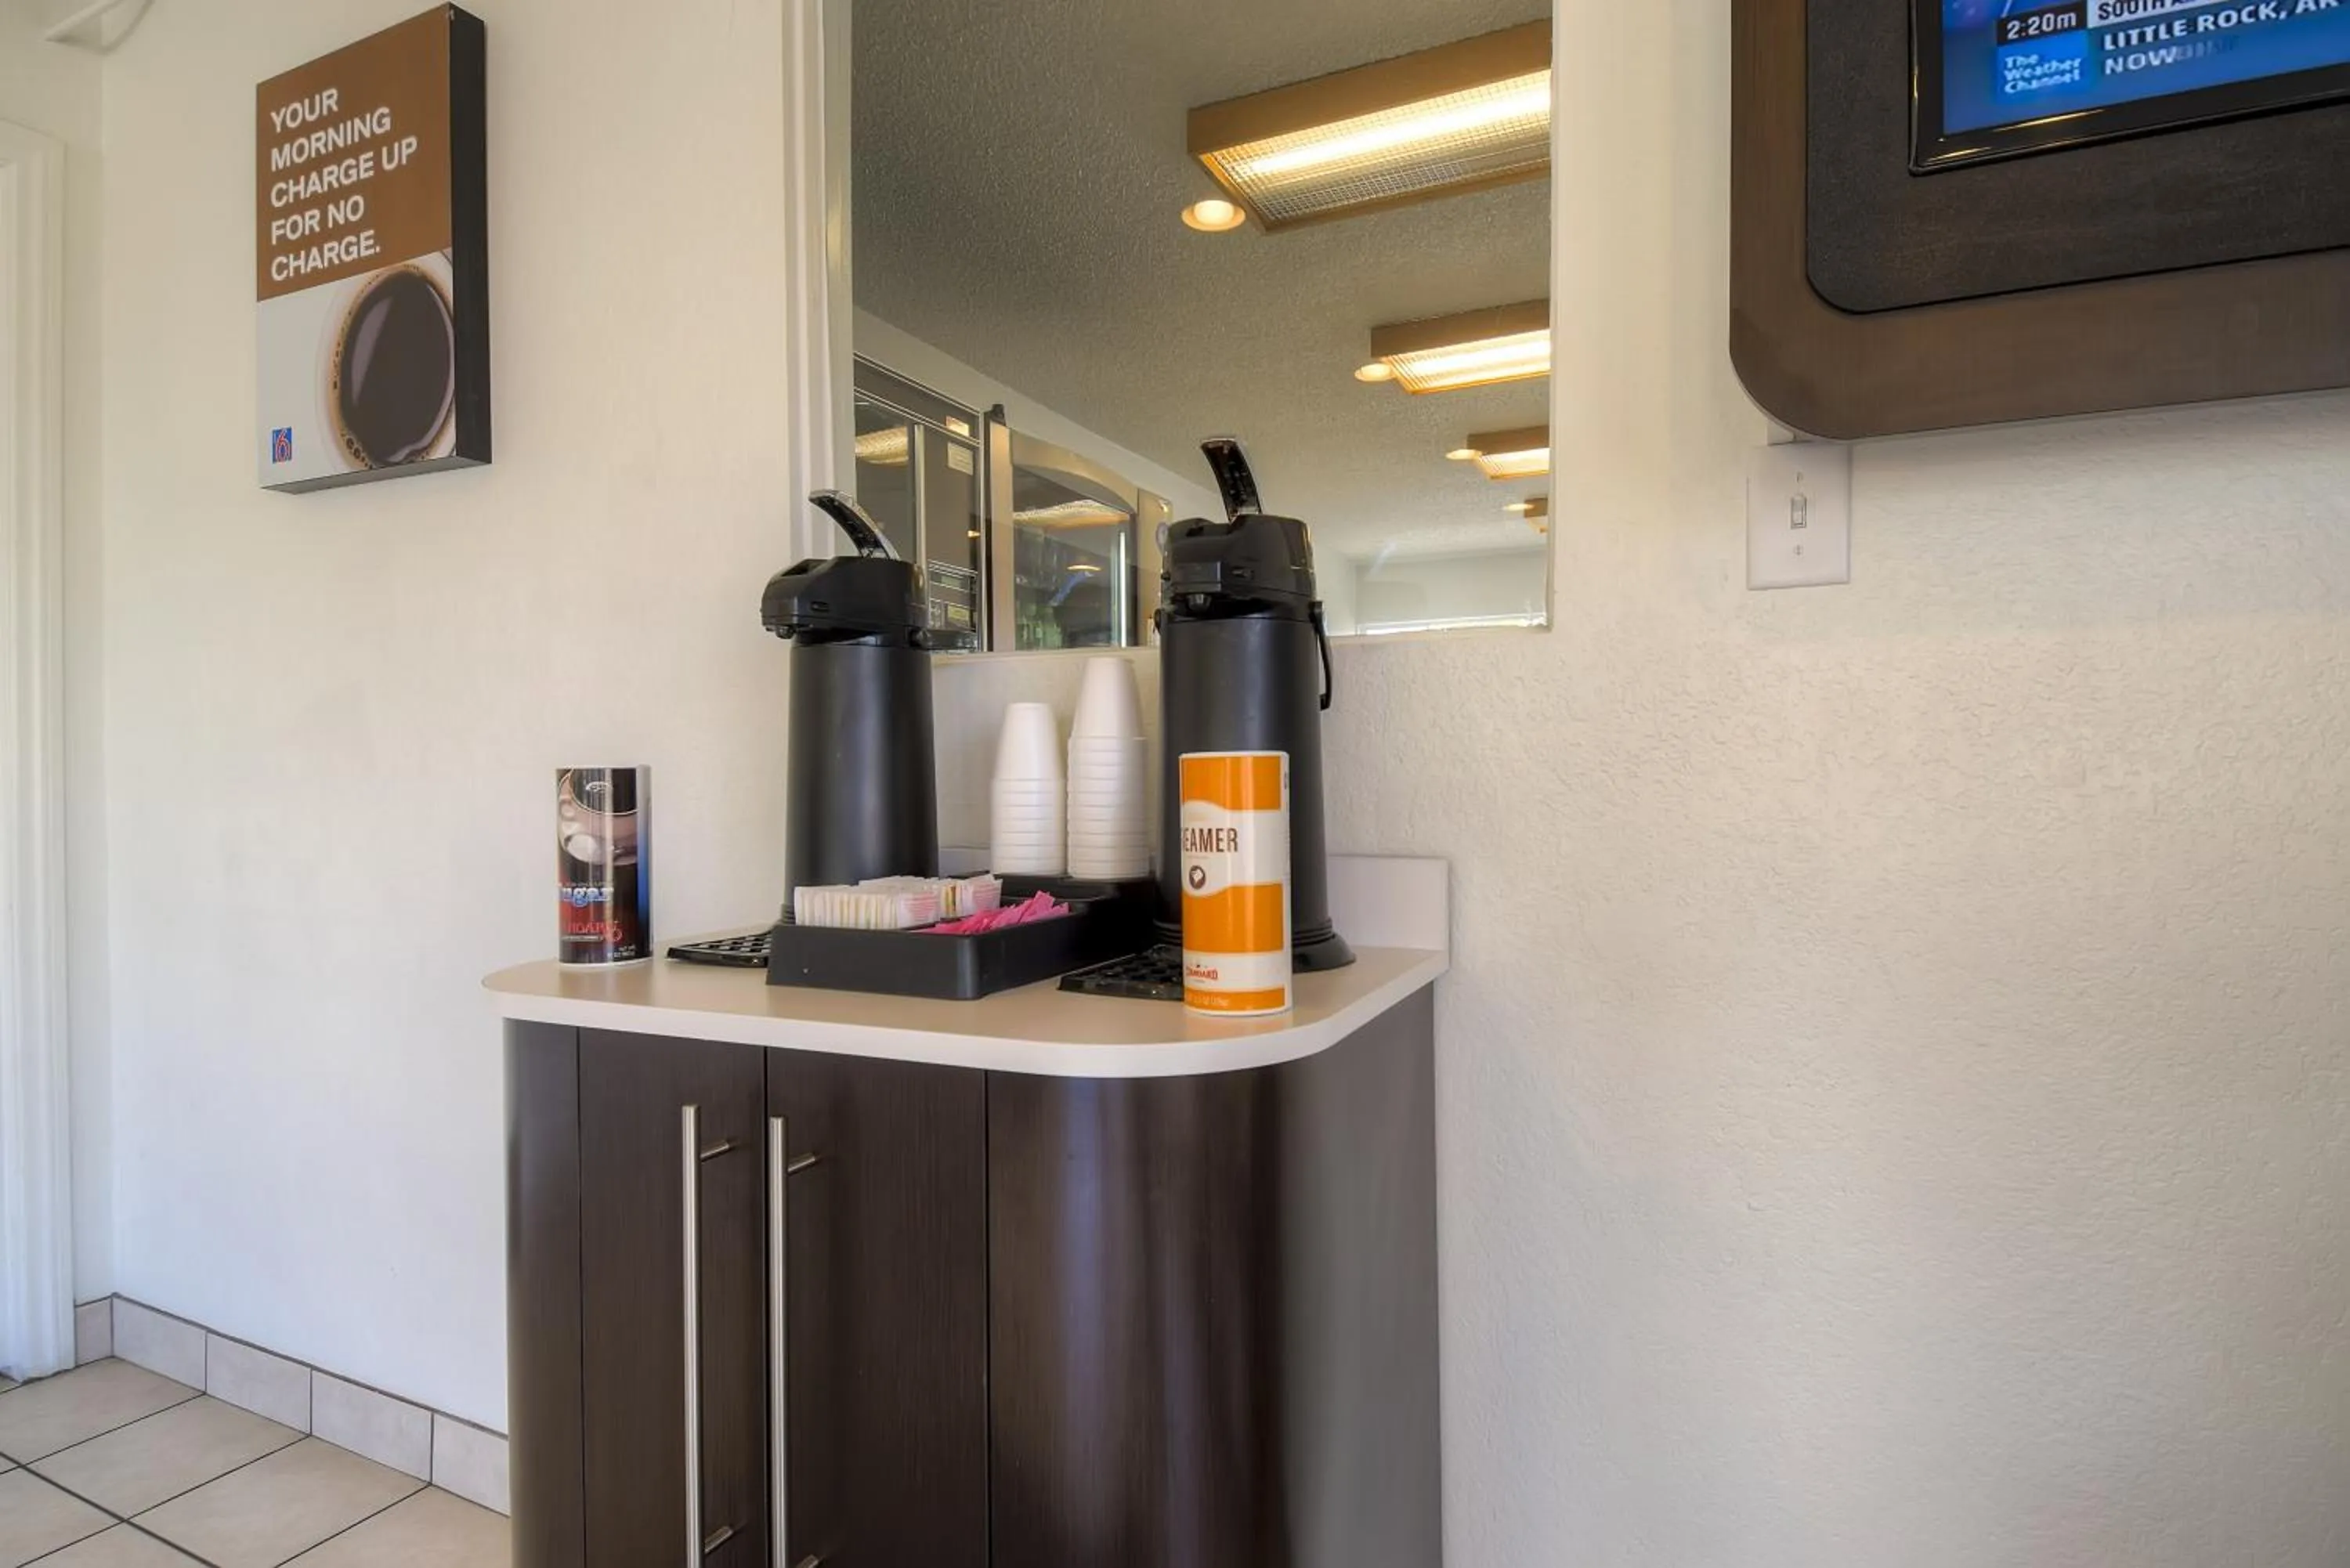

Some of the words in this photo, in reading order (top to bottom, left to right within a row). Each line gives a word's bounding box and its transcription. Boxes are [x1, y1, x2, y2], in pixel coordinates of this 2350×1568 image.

[2103, 19, 2188, 51] LITTLE
[2196, 1, 2288, 33] ROCK,
[2004, 57, 2081, 81] Weather
[2004, 68, 2081, 94] Channel
[2005, 54, 2039, 69] The
[2104, 45, 2178, 75] NOW
[271, 88, 338, 133] YOUR
[271, 107, 391, 172] MORNING
[270, 151, 374, 208] CHARGE
[381, 135, 418, 171] UP
[271, 208, 320, 245] FOR
[327, 195, 364, 228] NO
[270, 230, 381, 281] CHARGE.
